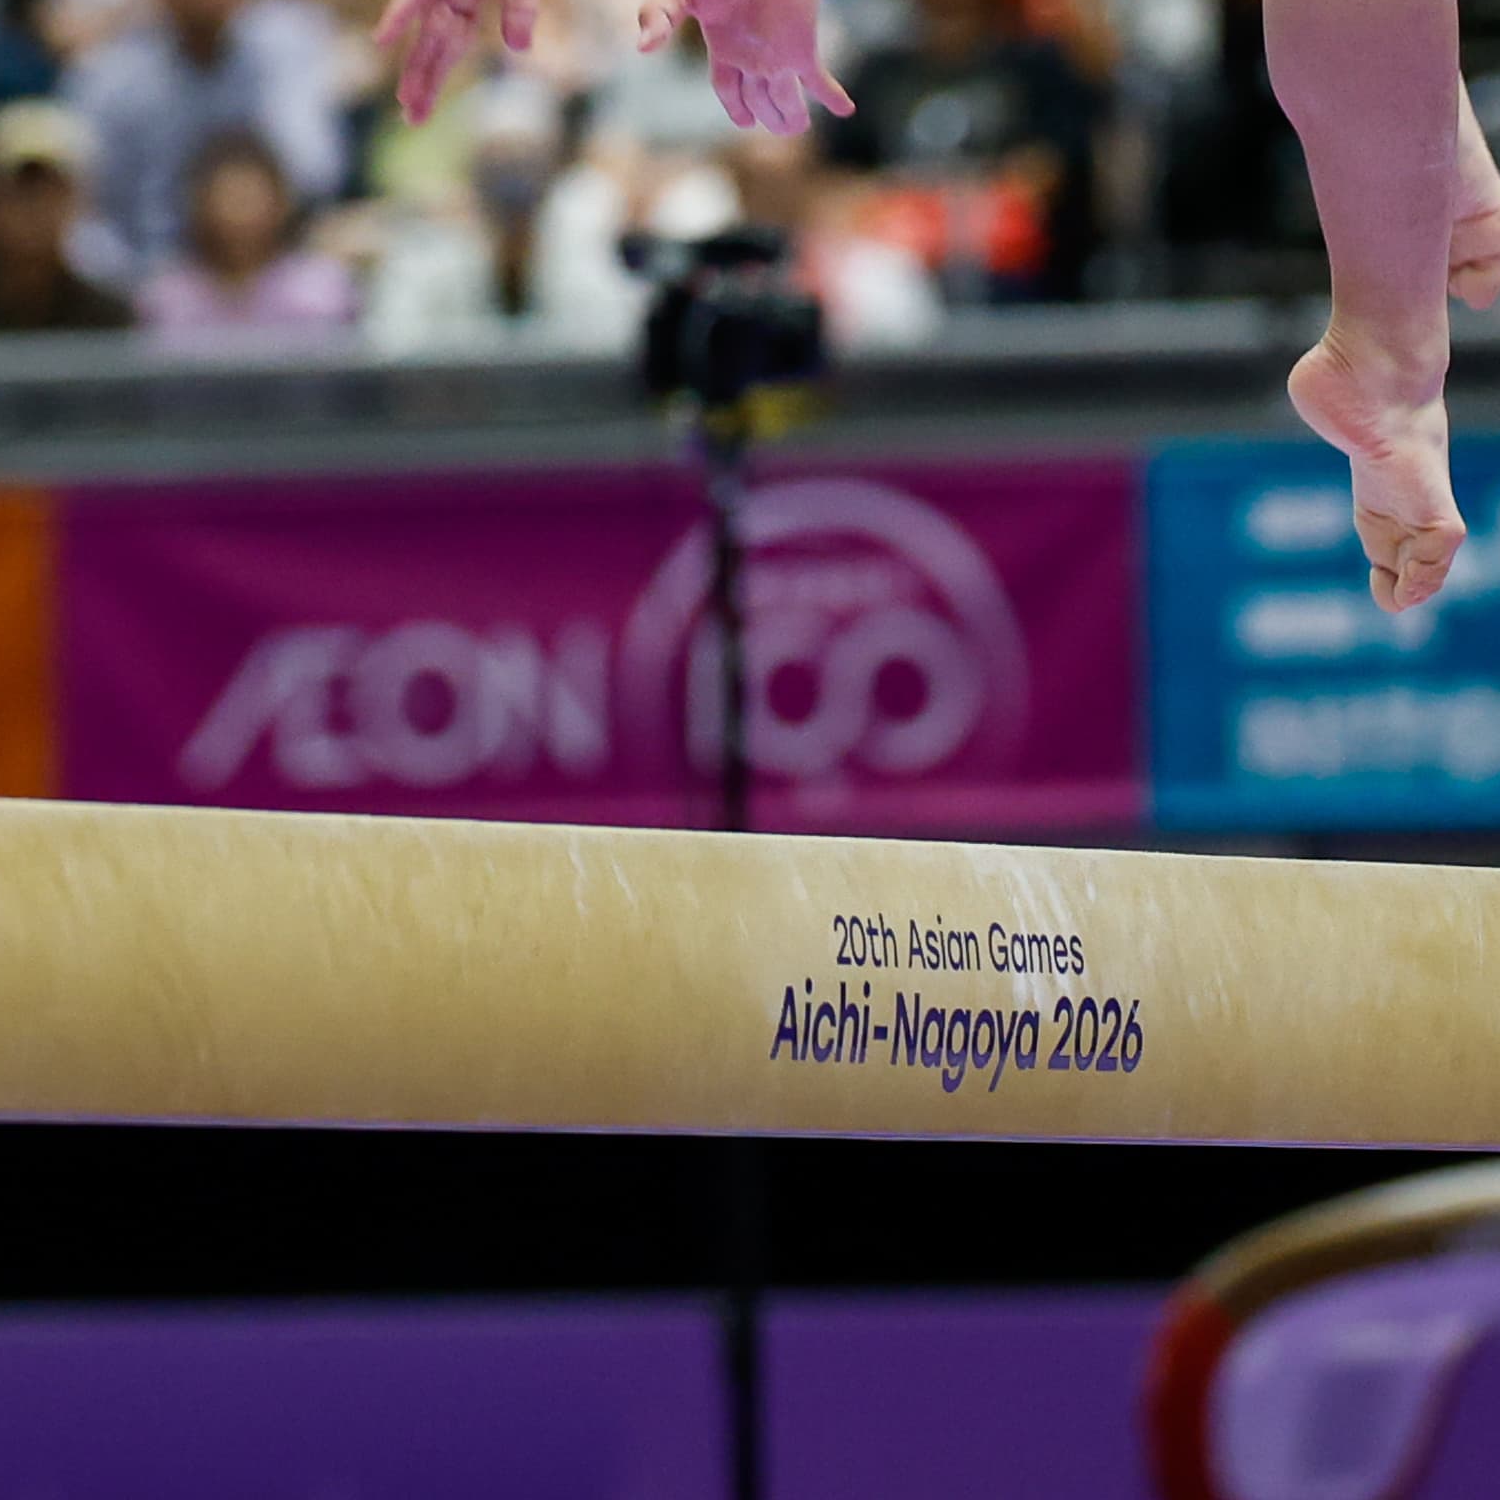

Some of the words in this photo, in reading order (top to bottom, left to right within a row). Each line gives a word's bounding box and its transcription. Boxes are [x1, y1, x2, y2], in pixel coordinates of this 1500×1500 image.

[833, 913, 898, 968] 20th
[908, 915, 981, 971] Asian
[988, 922, 1085, 975] Games
[769, 978, 1040, 1093] Aichi-Nagoya
[1047, 996, 1143, 1073] 2026
